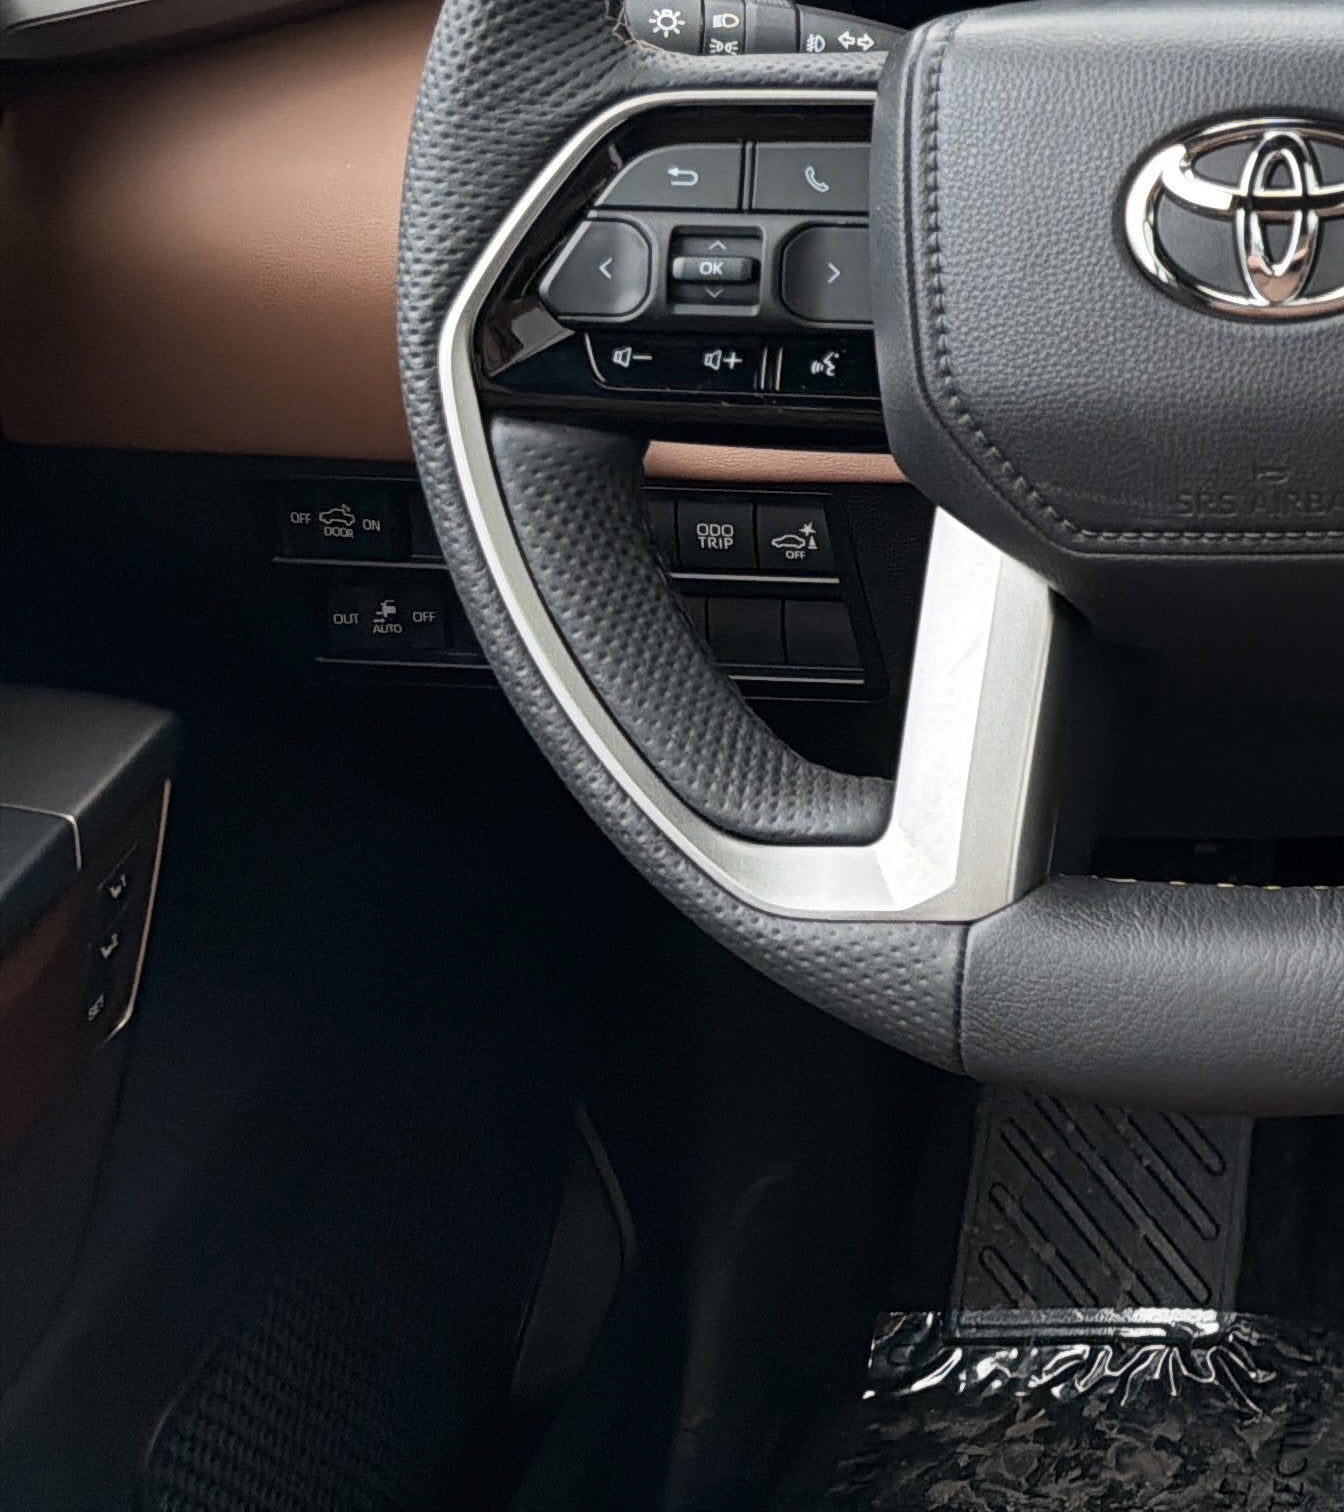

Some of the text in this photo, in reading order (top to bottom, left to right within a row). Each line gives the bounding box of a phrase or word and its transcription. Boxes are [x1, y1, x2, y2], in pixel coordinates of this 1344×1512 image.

[700, 261, 723, 276] OK
[290, 512, 312, 524] OFF
[362, 519, 381, 531] ON
[696, 523, 734, 537] ODO
[324, 526, 354, 538] DOOR
[698, 537, 734, 550] TRIP
[785, 550, 806, 560] OFF
[333, 613, 359, 625] OUT
[413, 611, 436, 622] OFF
[373, 624, 402, 634] AUTO
